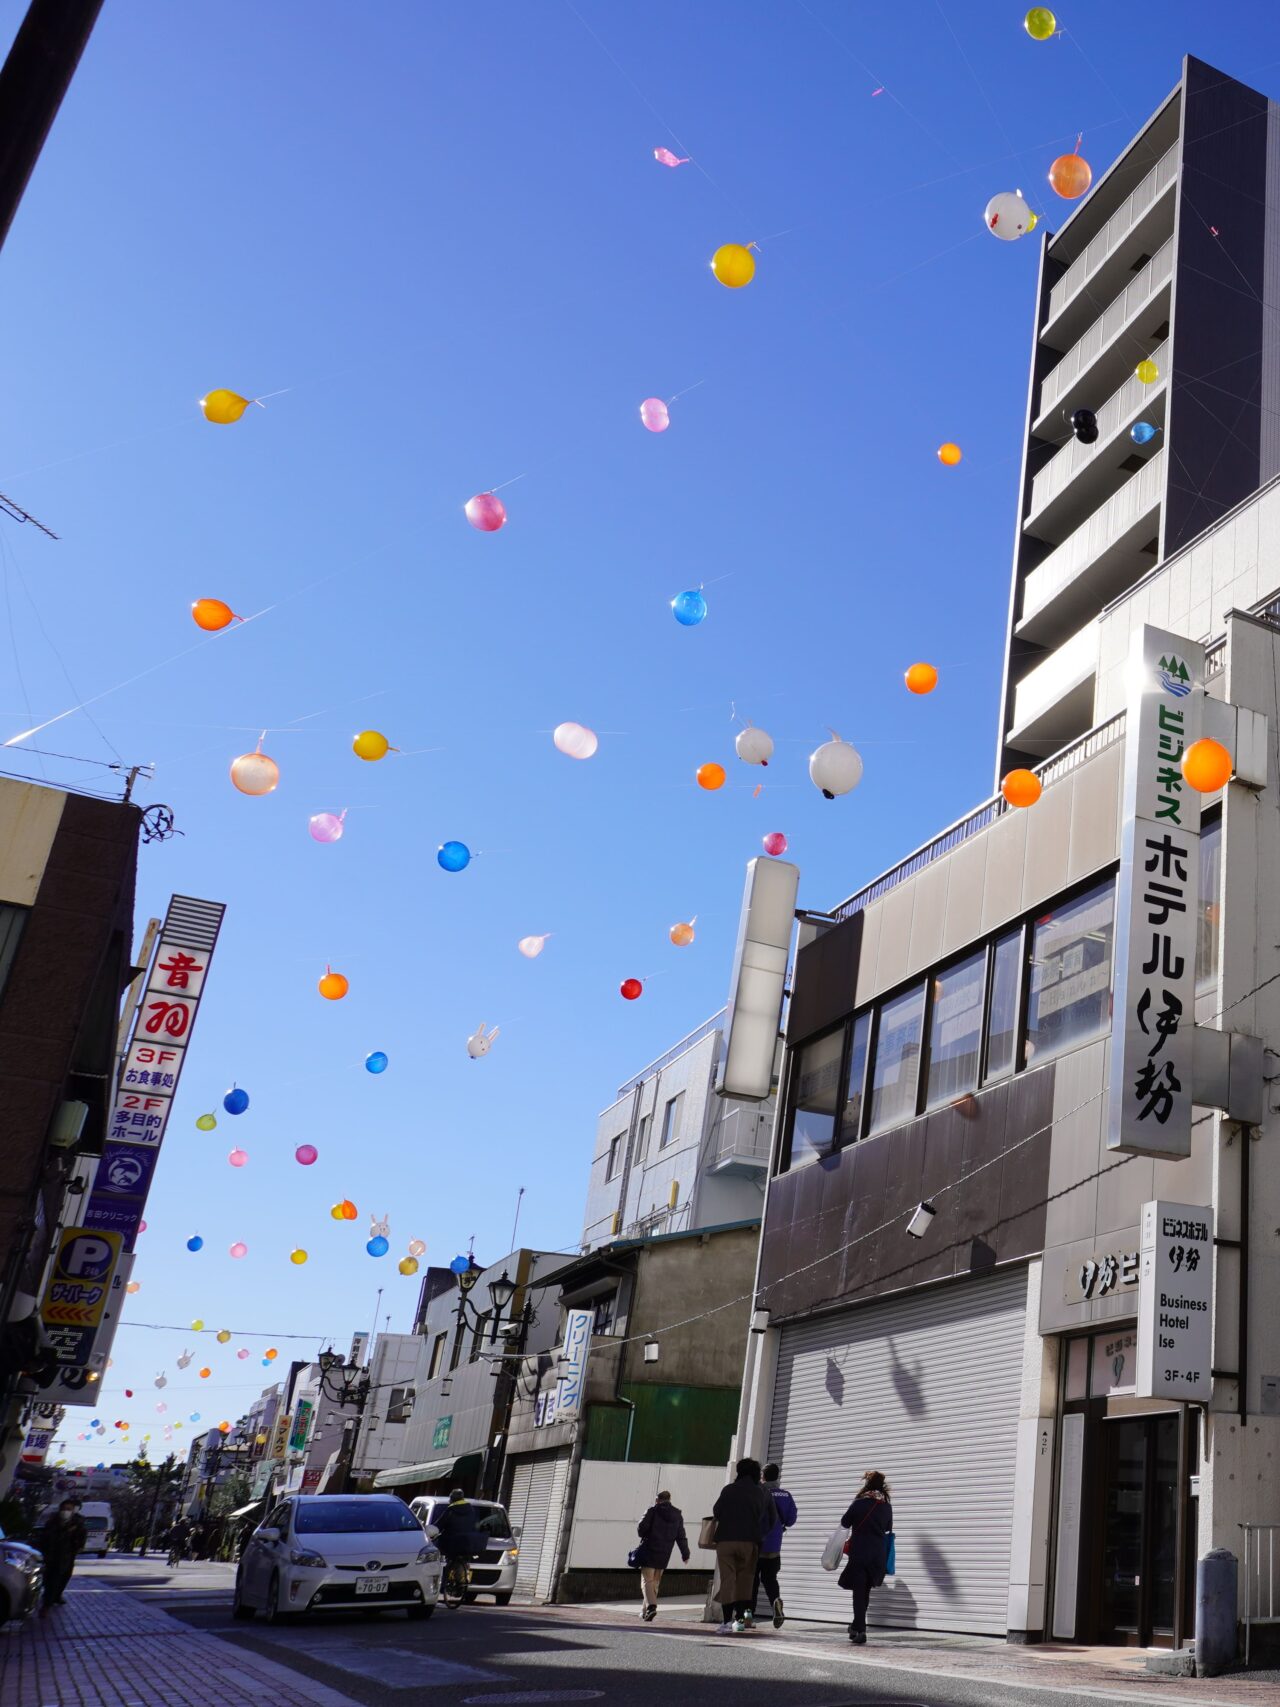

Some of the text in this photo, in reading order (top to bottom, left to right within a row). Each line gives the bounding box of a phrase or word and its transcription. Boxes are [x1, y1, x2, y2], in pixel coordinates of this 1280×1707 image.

[136, 1047, 177, 1065] 3F
[125, 1068, 174, 1089] お食事処
[122, 1095, 164, 1111] 2F
[115, 1110, 162, 1129] 多目的
[111, 1125, 158, 1142] ホール
[1162, 1217, 1207, 1242] ビジネスホテル
[67, 1237, 109, 1275] P
[1168, 1245, 1201, 1273] 伊勢
[1160, 1293, 1208, 1312] Business
[1159, 1313, 1189, 1330] Hotel
[47, 1327, 83, 1360] 空
[1159, 1333, 1175, 1349] Ise
